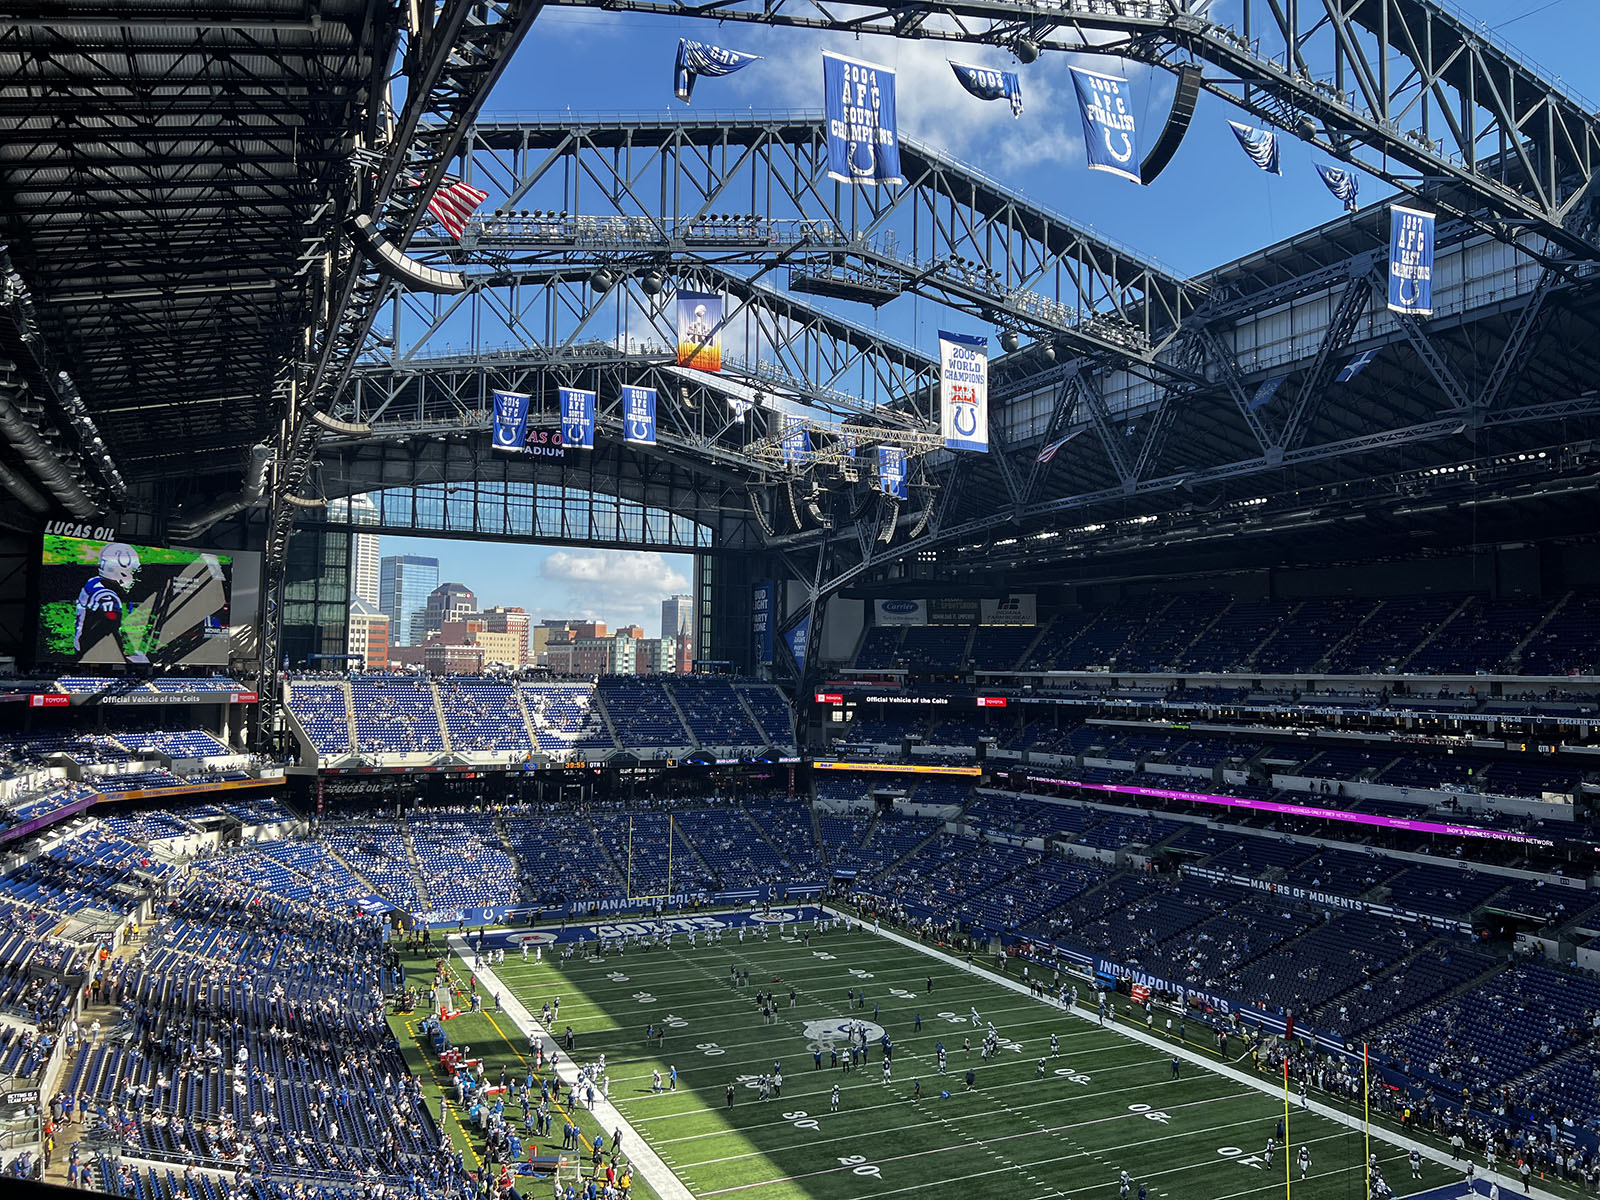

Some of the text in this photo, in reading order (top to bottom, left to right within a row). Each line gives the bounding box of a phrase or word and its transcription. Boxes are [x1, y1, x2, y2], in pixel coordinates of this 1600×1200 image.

[844, 64, 876, 86] 2004
[842, 80, 880, 109] AFC
[1093, 90, 1125, 114] AFC
[843, 106, 879, 126] SOUTH
[1402, 214, 1423, 231] 1987
[1399, 228, 1424, 252] AFC
[953, 347, 975, 361] 2006
[949, 359, 981, 373] WORLD
[945, 369, 985, 385] CHAMPIONS
[503, 397, 520, 407] 2014
[513, 446, 565, 457] TADIUM
[44, 520, 115, 541] LUCAS OIL
[886, 601, 914, 609] Carrier
[102, 695, 130, 703] Official
[1465, 829, 1505, 840] BUSINESS-ONLY
[1526, 837, 1553, 846] NETWORK
[573, 892, 706, 911] INDIANAPOLIS COLTS
[1251, 878, 1362, 910] MAKERS OF MOMENTS
[590, 917, 727, 938] COLTS
[1100, 960, 1229, 1013] INDIANAPOLIS COLTS
[696, 1043, 725, 1055] 50
[782, 1111, 819, 1128] 30
[1128, 1104, 1172, 1121] 20
[837, 1155, 881, 1176] 20
[1217, 1147, 1265, 1166] 10
